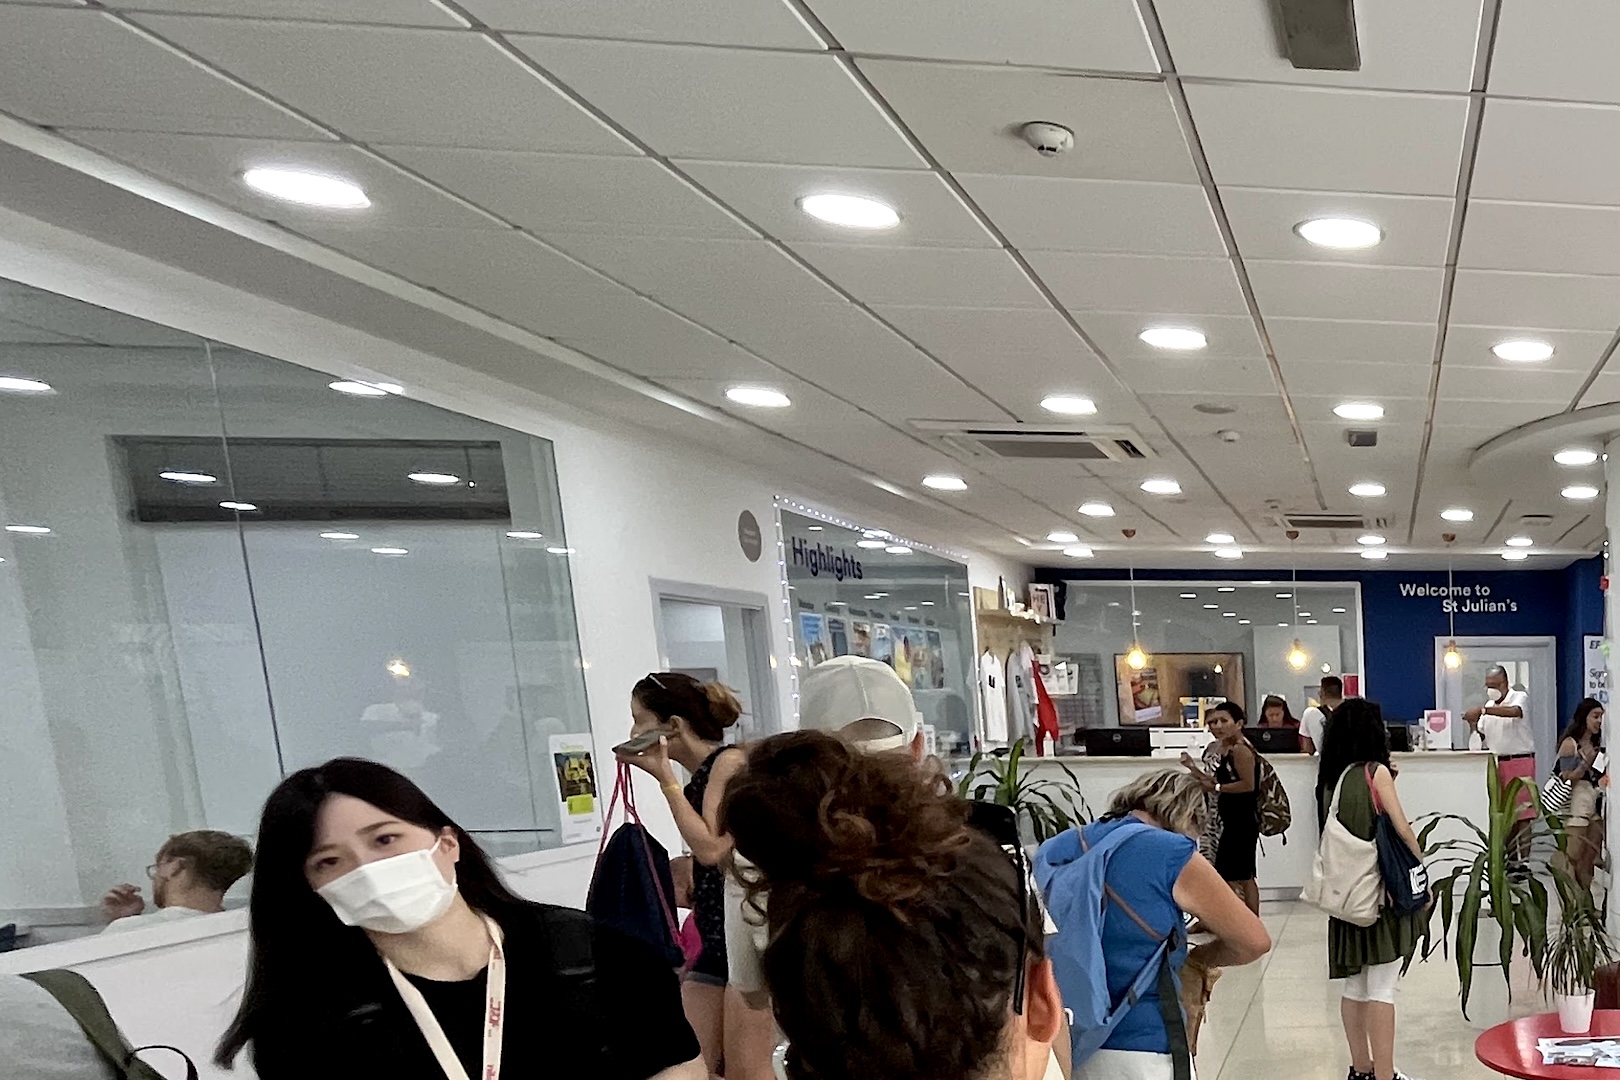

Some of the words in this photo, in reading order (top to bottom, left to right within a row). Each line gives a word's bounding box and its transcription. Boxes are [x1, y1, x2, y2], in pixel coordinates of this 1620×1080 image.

[791, 537, 863, 582] Highlights
[1400, 583, 1471, 597] Welcome
[1474, 584, 1490, 596] to
[1442, 599, 1458, 613] St
[1461, 598, 1517, 613] Julian's
[1589, 640, 1601, 650] EF
[1408, 863, 1427, 895] E
